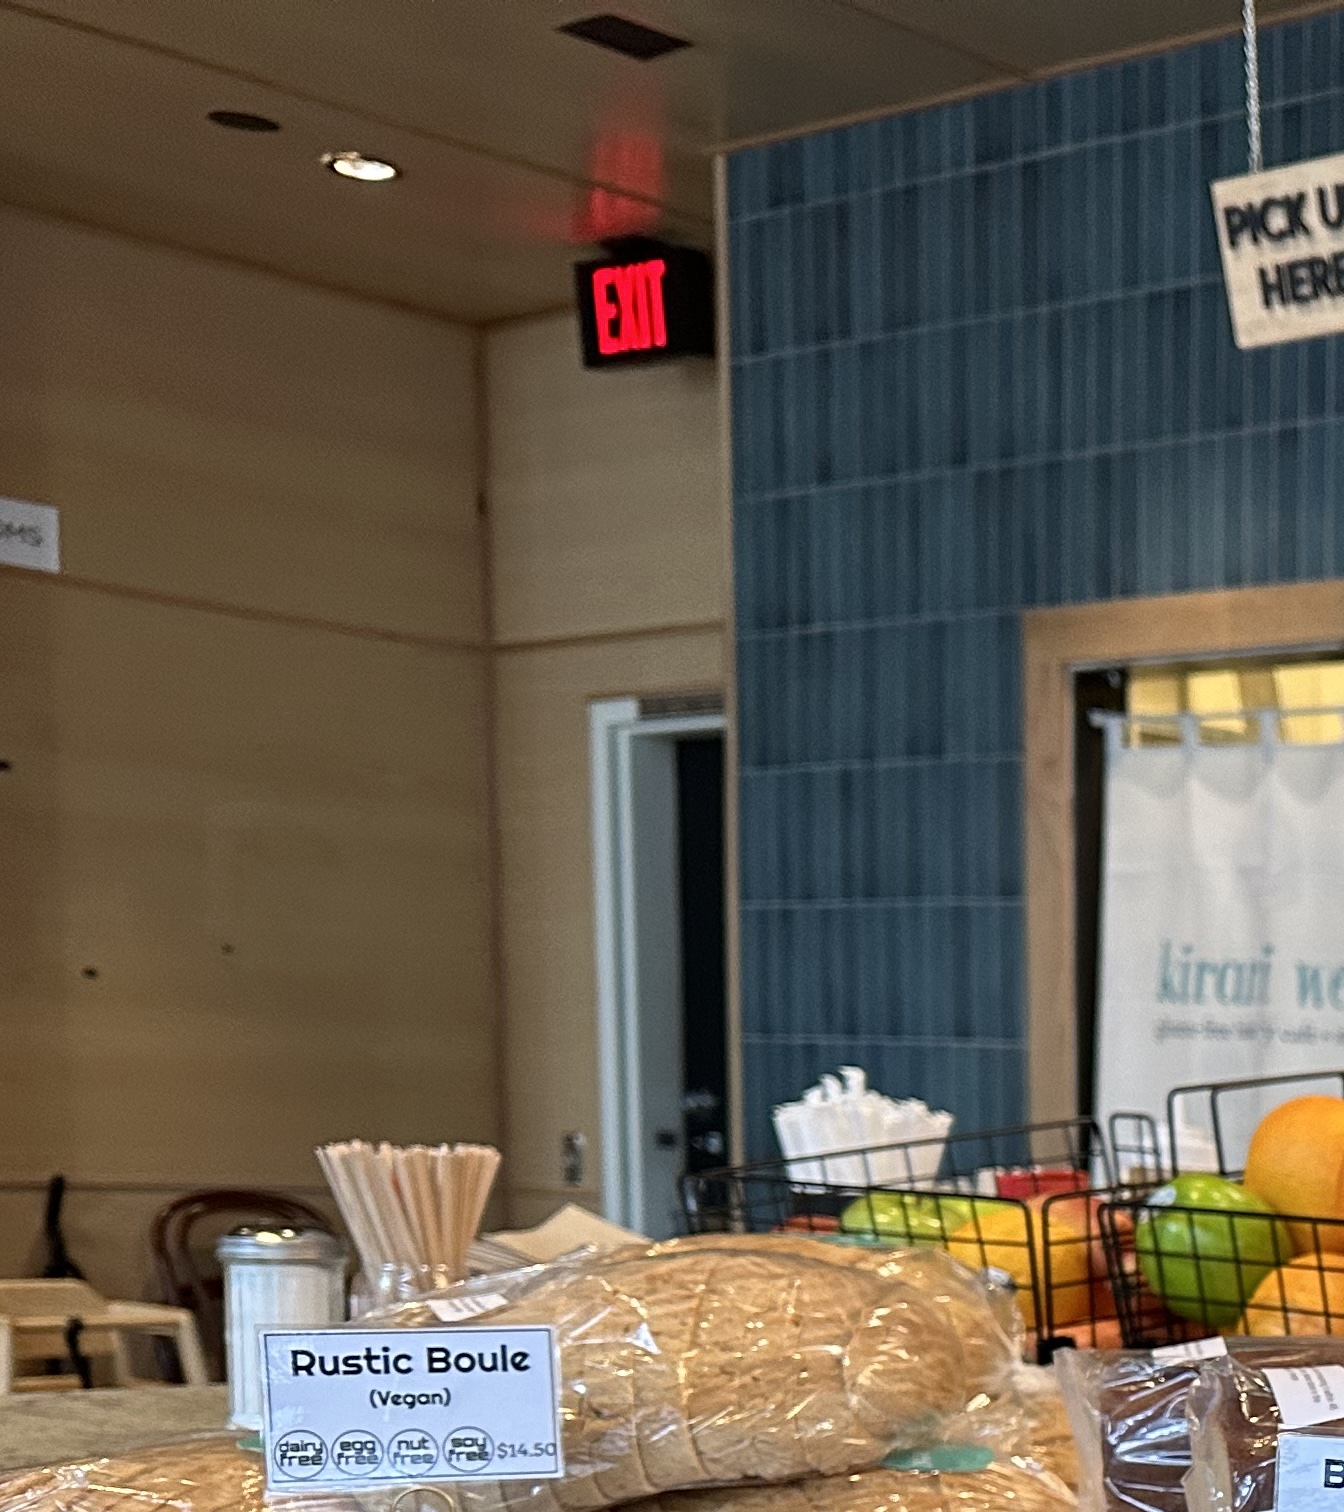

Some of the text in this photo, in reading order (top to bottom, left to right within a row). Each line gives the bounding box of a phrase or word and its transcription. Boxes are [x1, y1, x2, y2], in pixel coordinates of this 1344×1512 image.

[1224, 191, 1310, 249] PICK
[593, 259, 667, 355] EXIT
[290, 1344, 531, 1376] Rustic Boule
[369, 1388, 451, 1409] (Vegan)
[279, 1439, 323, 1455] dairy
[340, 1440, 376, 1455] egg
[397, 1437, 429, 1450] nut
[451, 1437, 487, 1451] soy
[497, 1442, 557, 1460] $14.50
[280, 1453, 323, 1467] free
[337, 1451, 379, 1466] free
[393, 1452, 434, 1465] free
[448, 1448, 490, 1463] free
